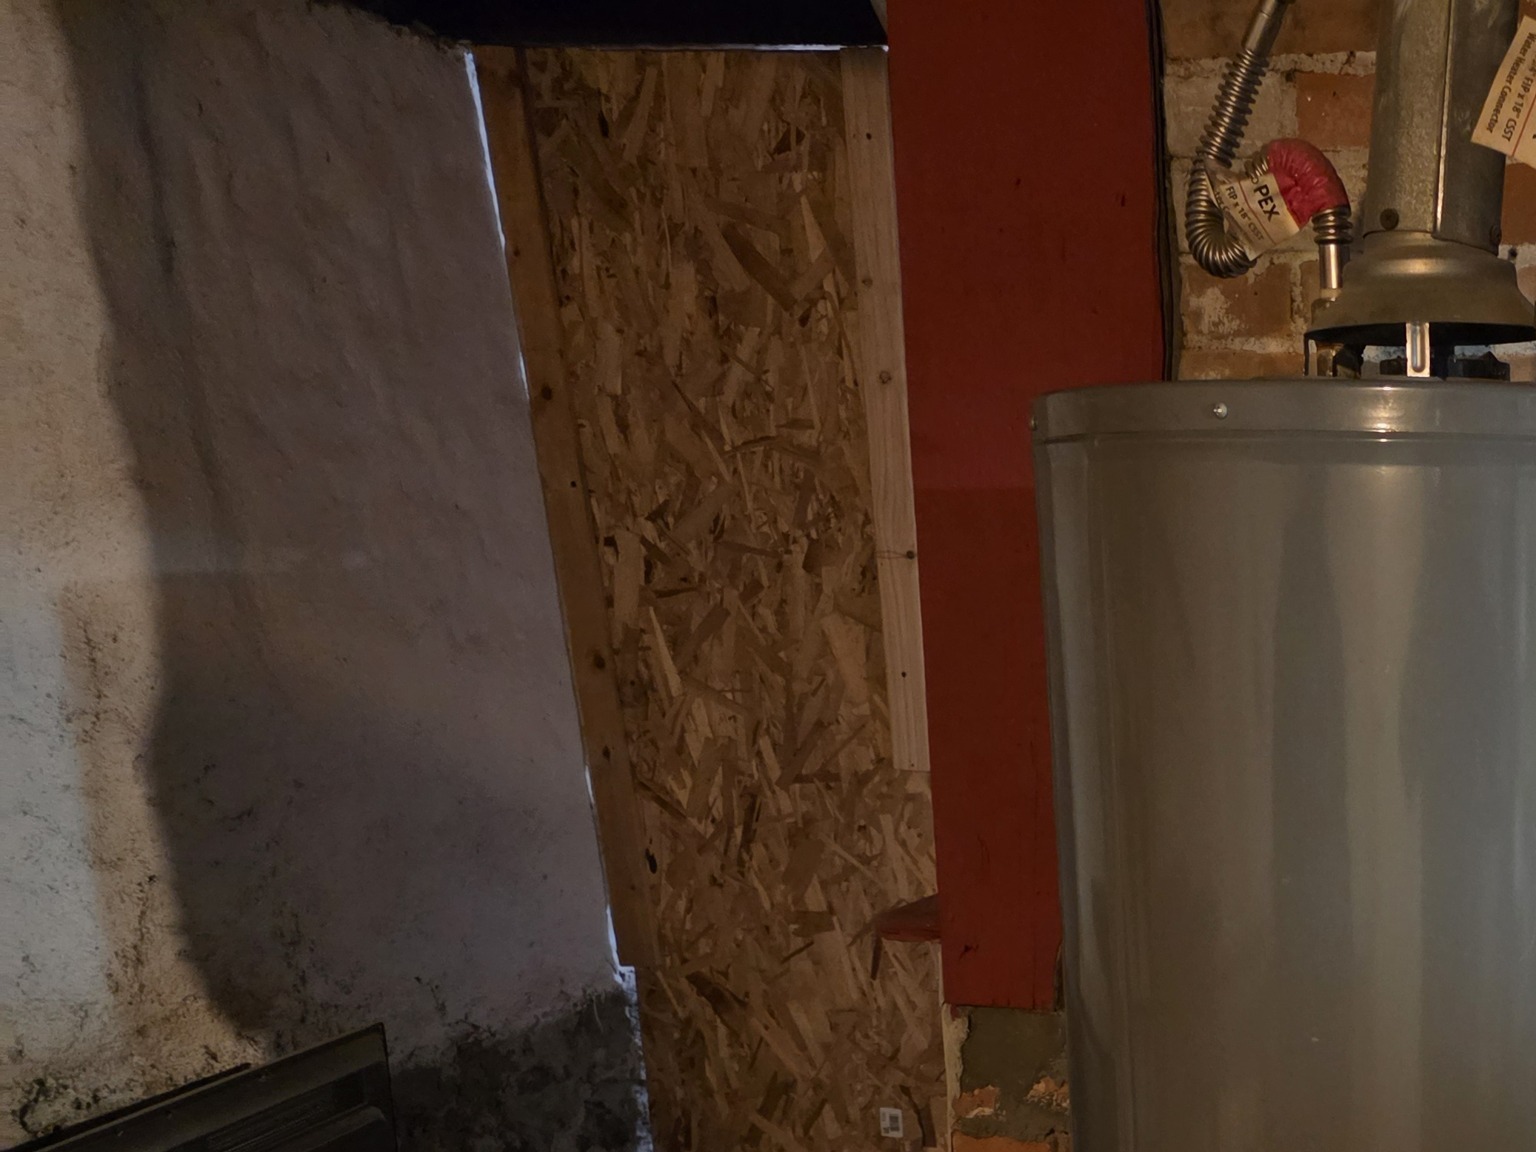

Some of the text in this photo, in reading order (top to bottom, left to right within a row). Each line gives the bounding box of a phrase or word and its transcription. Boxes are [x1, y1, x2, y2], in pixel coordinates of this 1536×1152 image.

[1506, 57, 1526, 85] Heater
[1523, 76, 1534, 93] FIP
[1486, 87, 1512, 133] Connector
[1501, 118, 1517, 142] CSST
[1225, 185, 1238, 201] FIP
[1253, 184, 1280, 222] PEX
